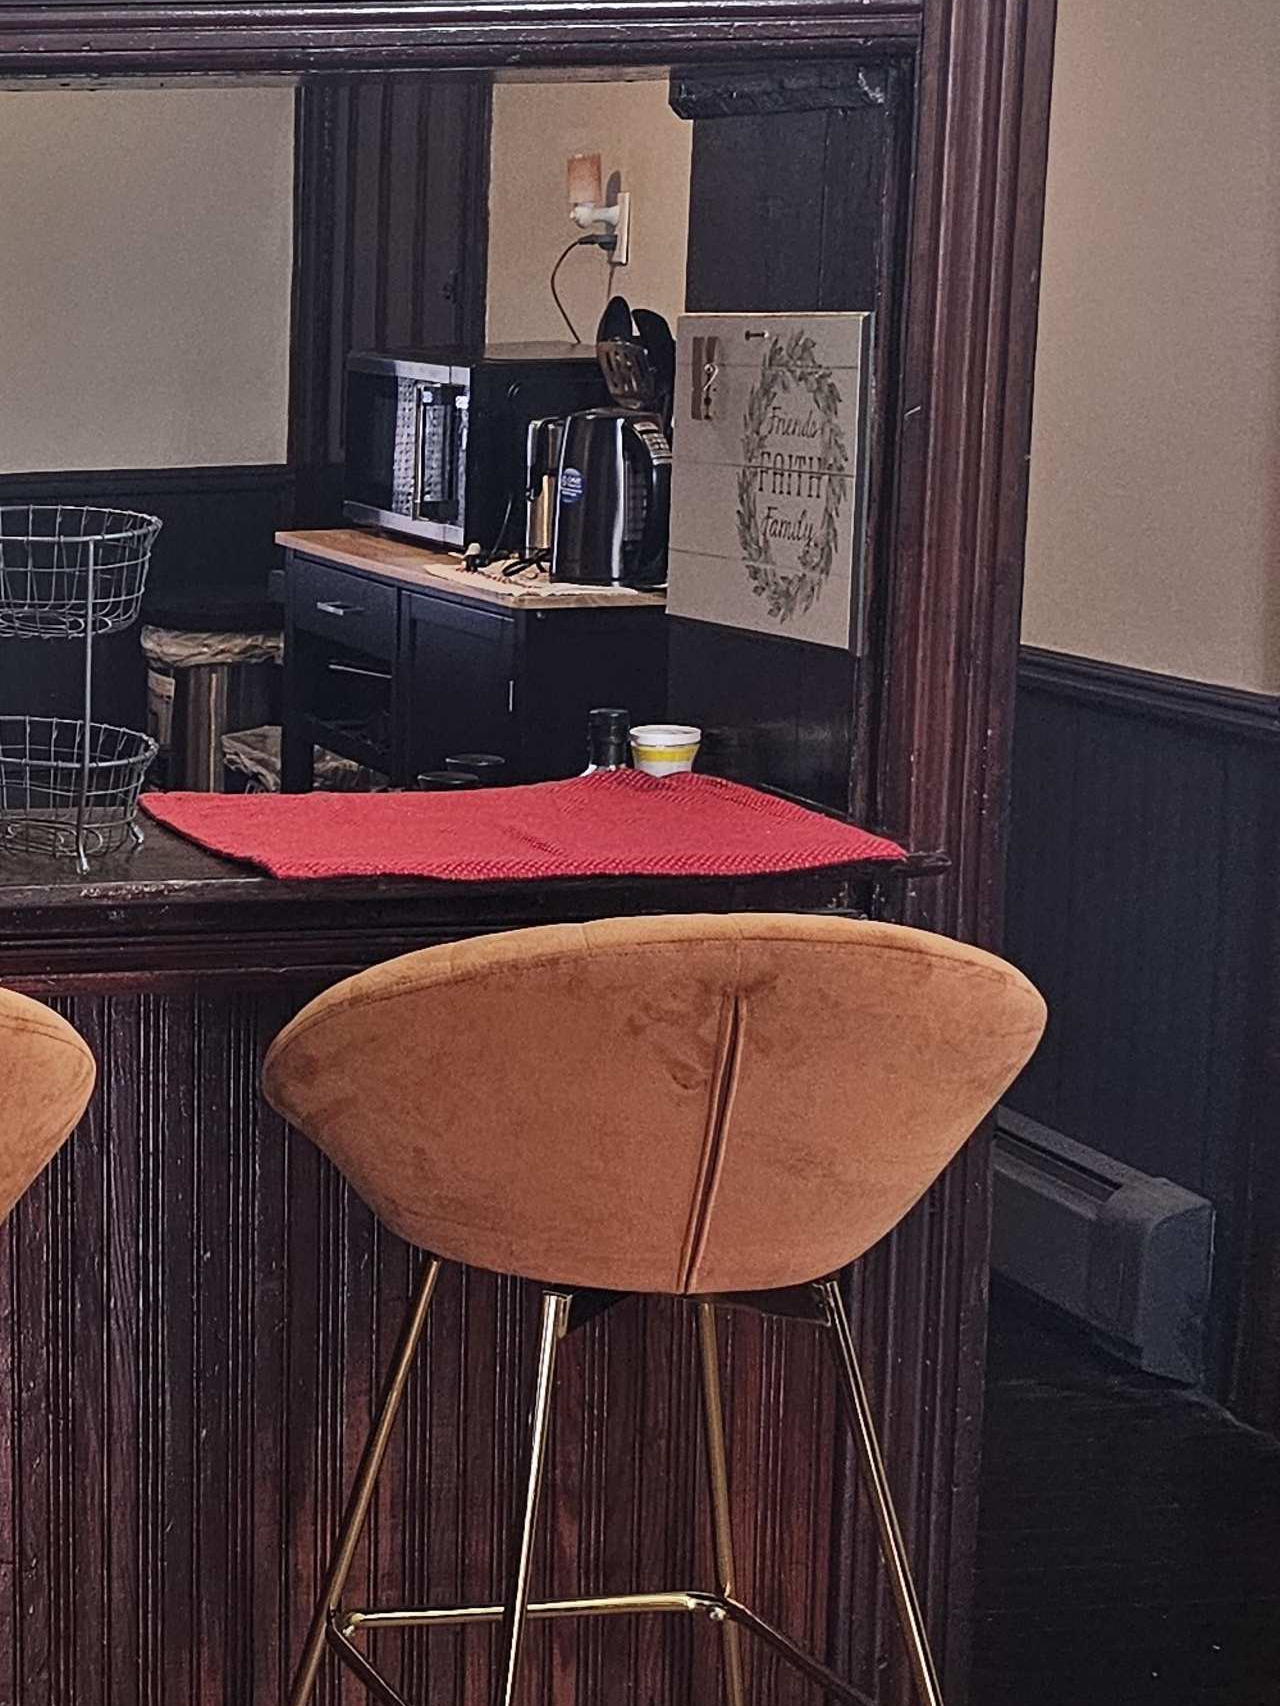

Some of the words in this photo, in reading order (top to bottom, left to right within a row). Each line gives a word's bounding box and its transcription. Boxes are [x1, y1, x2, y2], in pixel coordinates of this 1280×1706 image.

[767, 405, 819, 438] Friends
[758, 451, 822, 499] FAITH
[761, 505, 815, 548] Family
